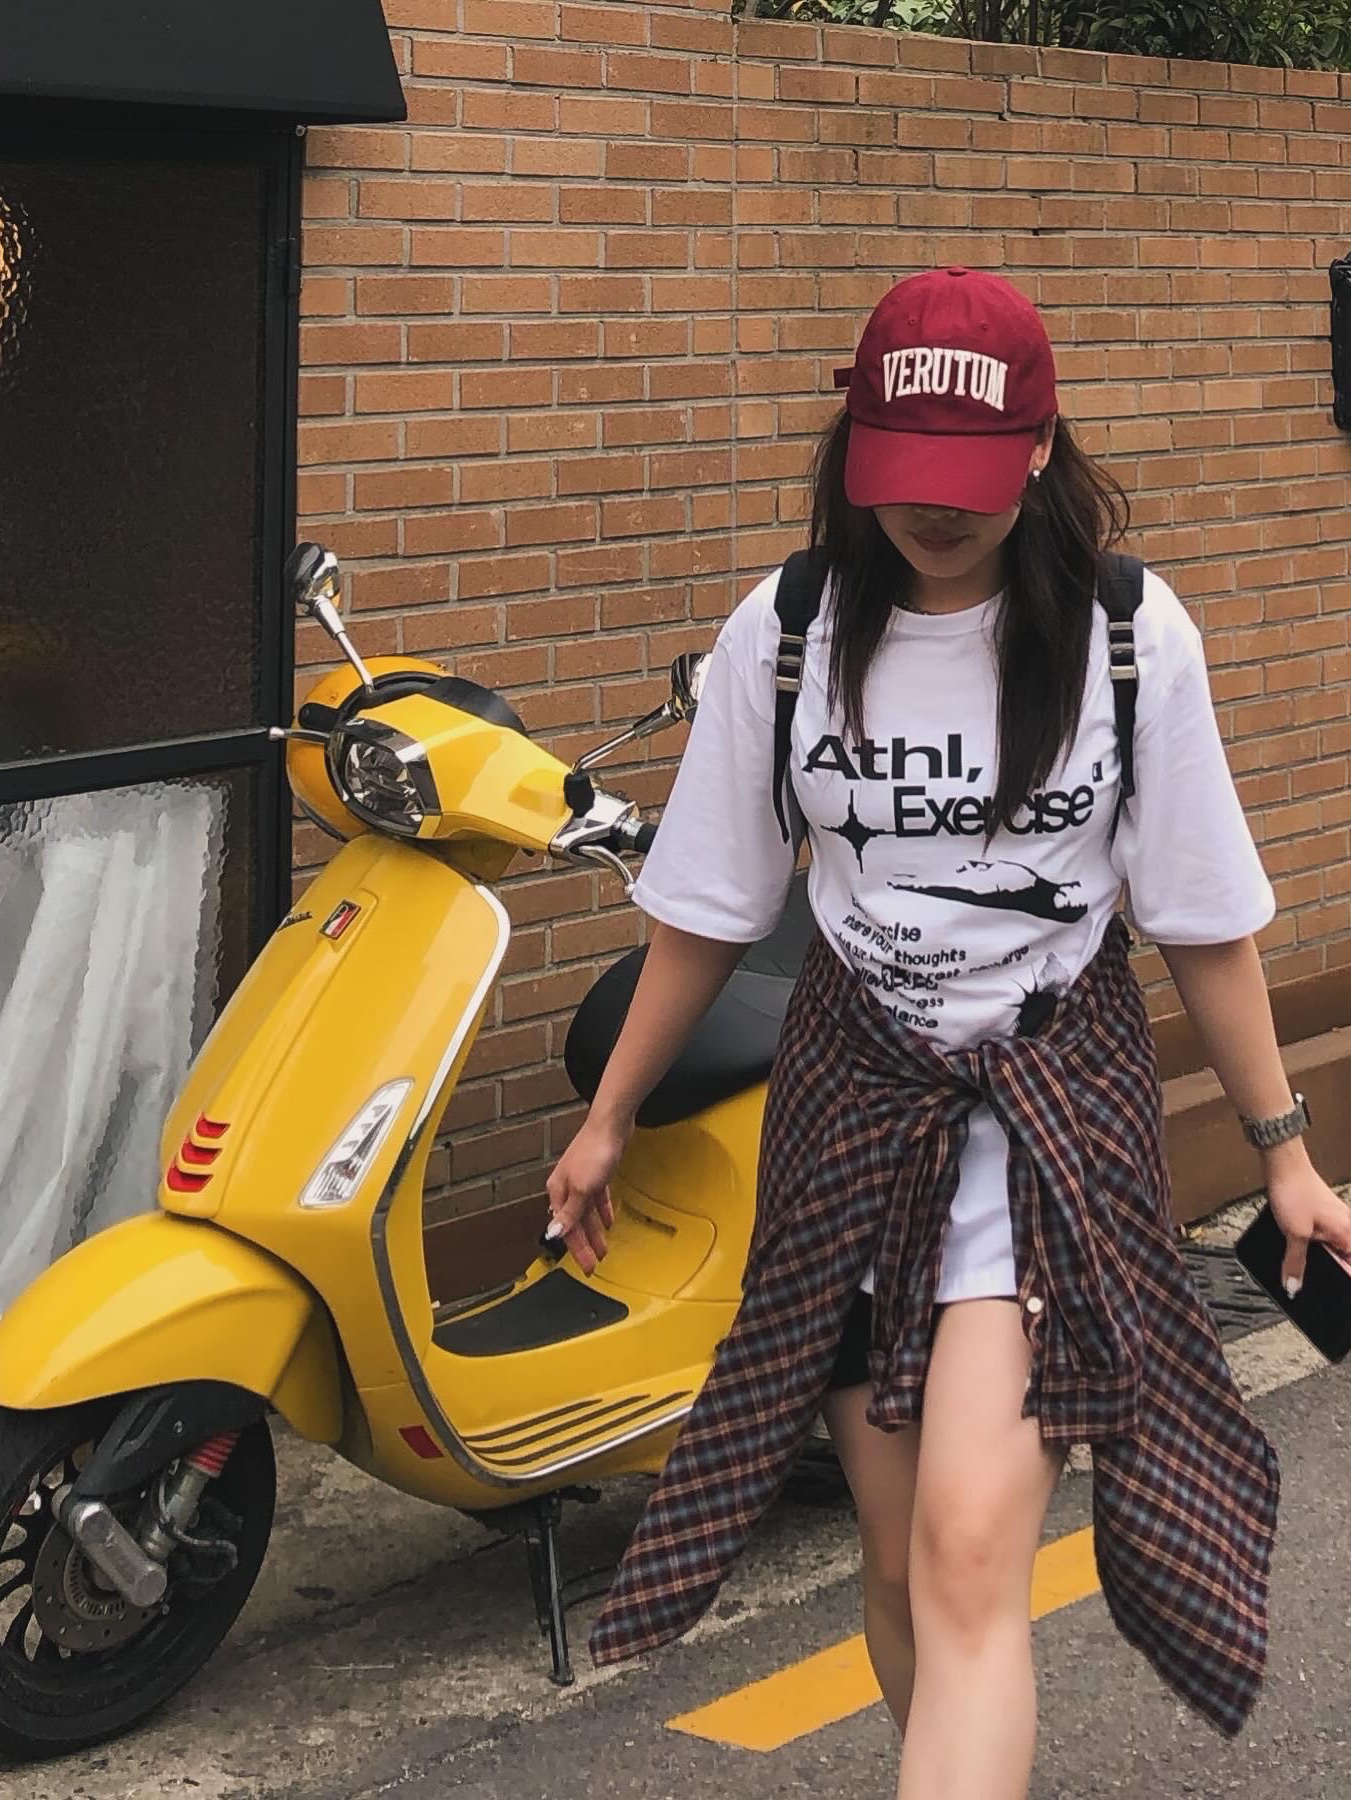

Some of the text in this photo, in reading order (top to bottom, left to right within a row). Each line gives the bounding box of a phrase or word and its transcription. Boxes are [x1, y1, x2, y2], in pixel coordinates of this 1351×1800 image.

[882, 347, 1009, 412] VERUTUM
[802, 734, 983, 783] Athl,
[867, 930, 893, 955] your
[894, 948, 967, 967] thoughts
